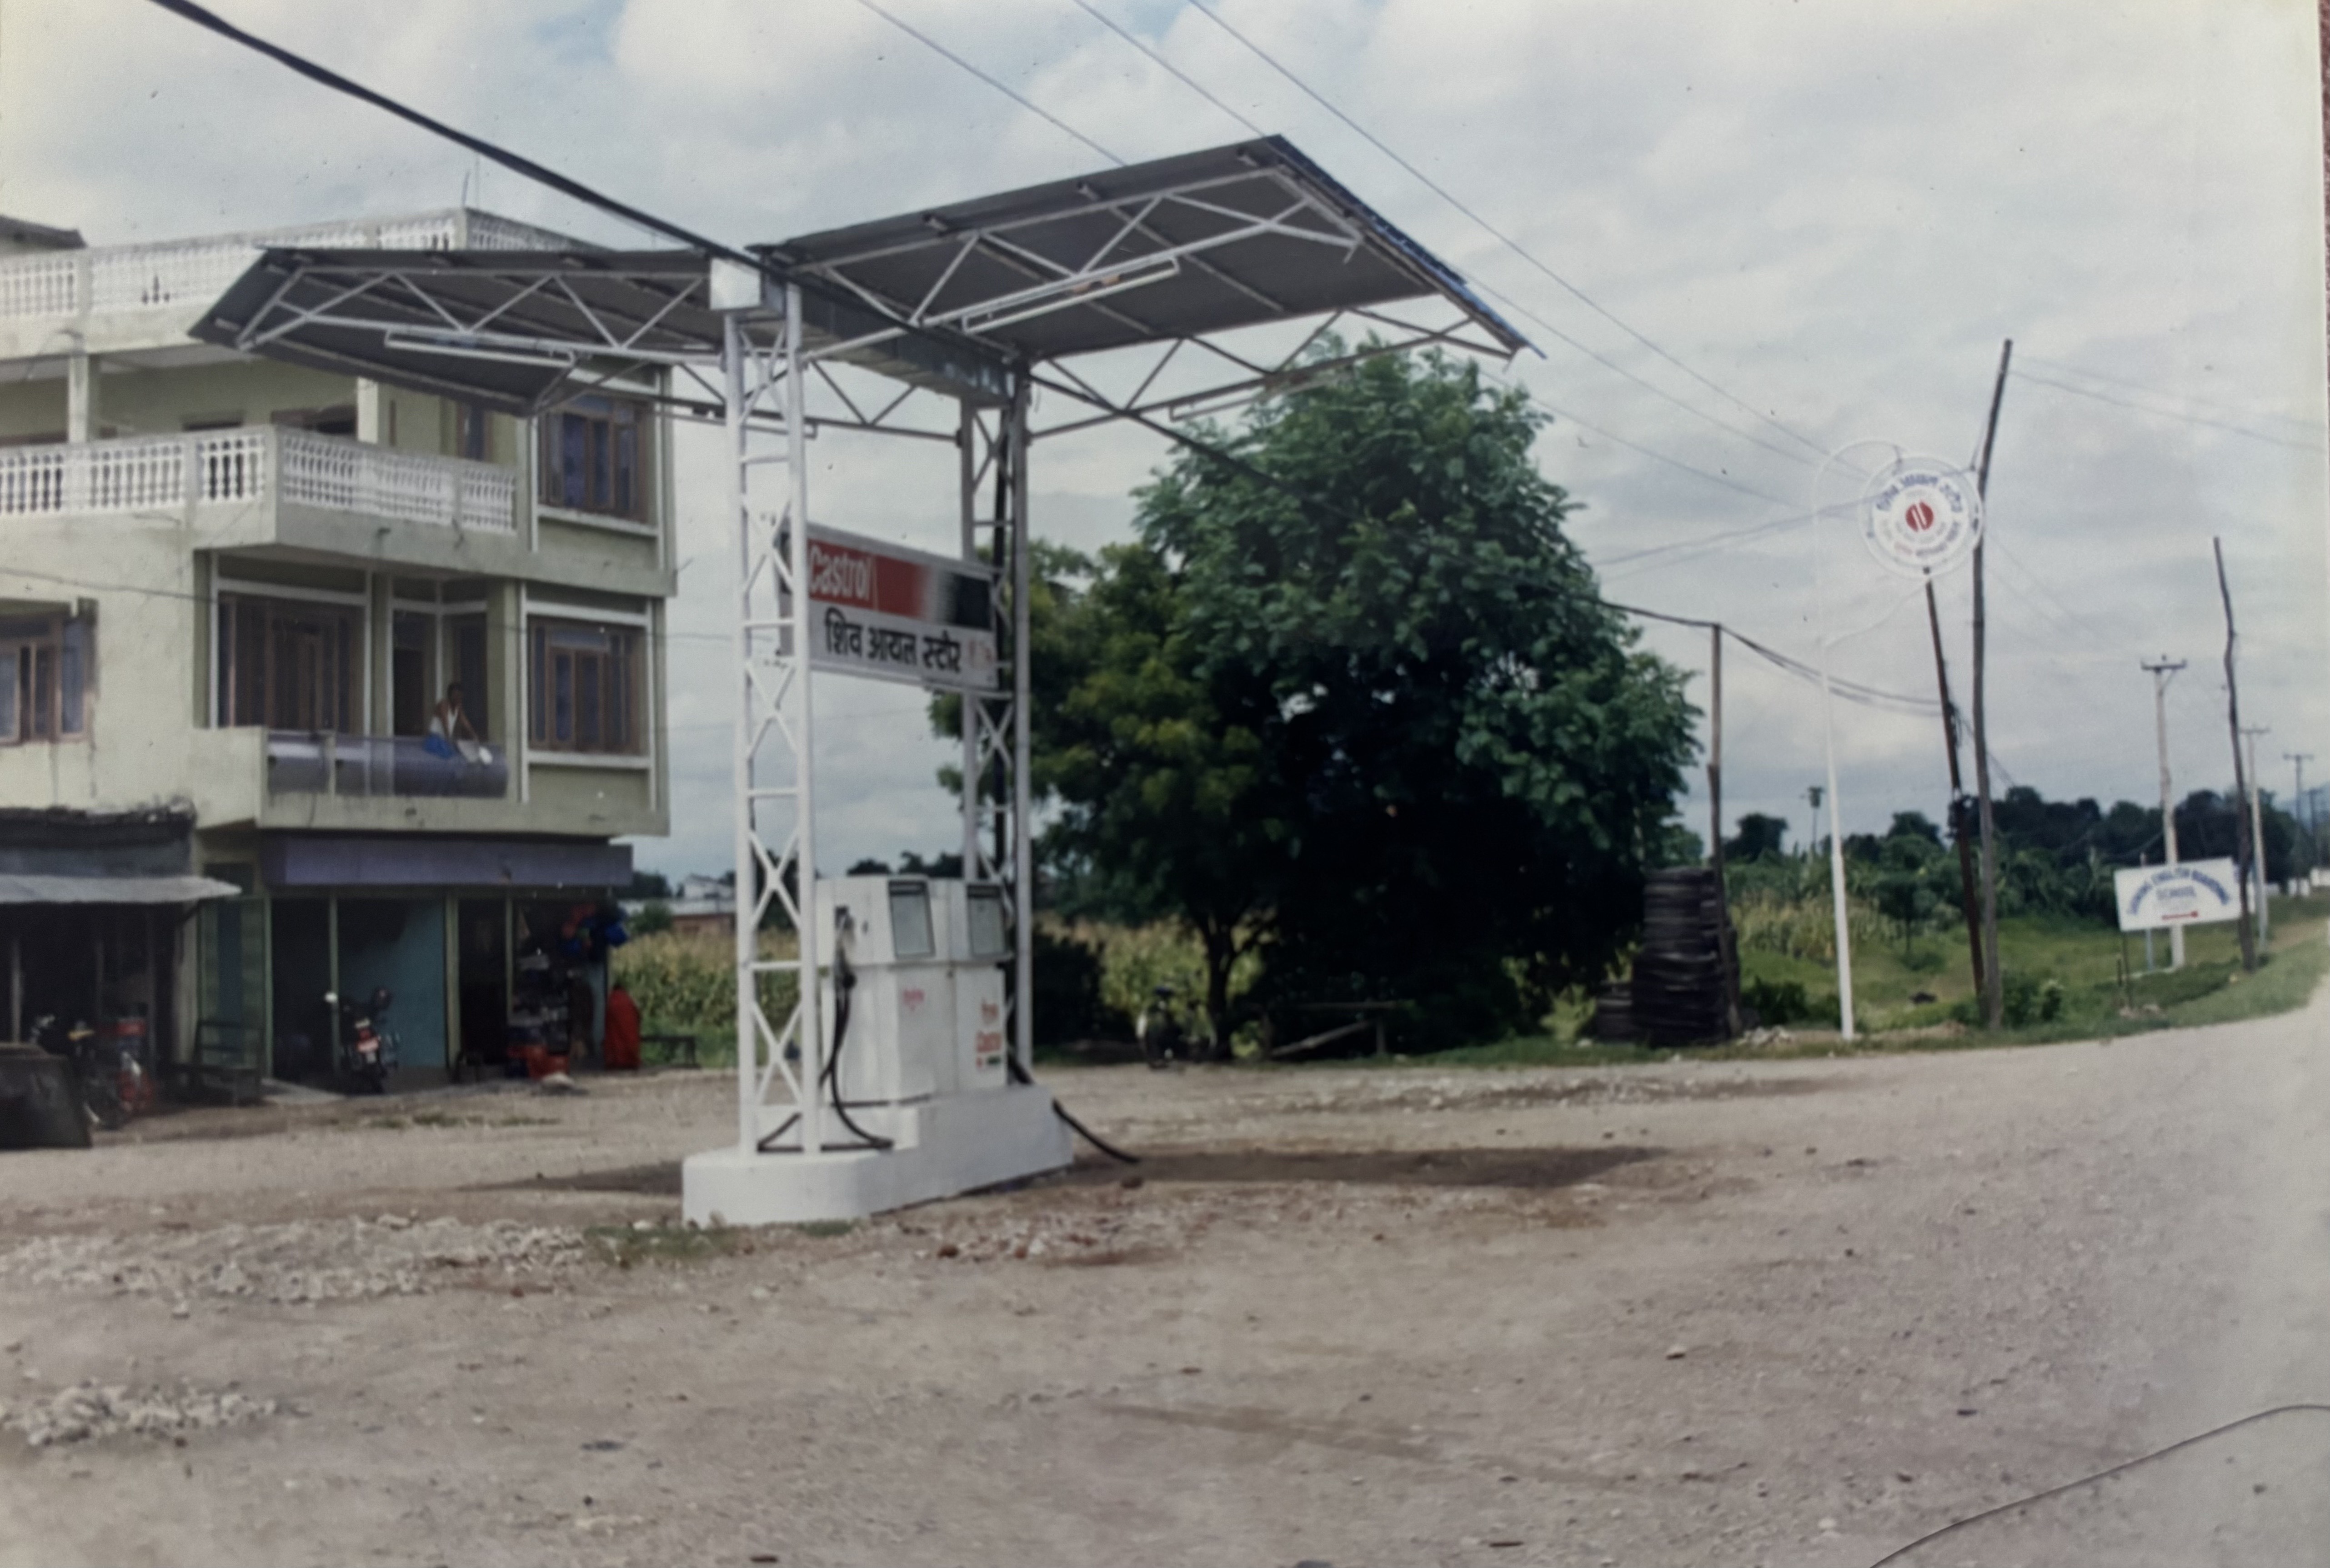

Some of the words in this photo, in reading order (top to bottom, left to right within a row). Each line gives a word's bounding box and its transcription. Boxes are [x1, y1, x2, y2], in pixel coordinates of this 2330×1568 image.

[809, 545, 872, 601] Castrol
[824, 607, 862, 656] शिव
[922, 630, 961, 673] स्टोर
